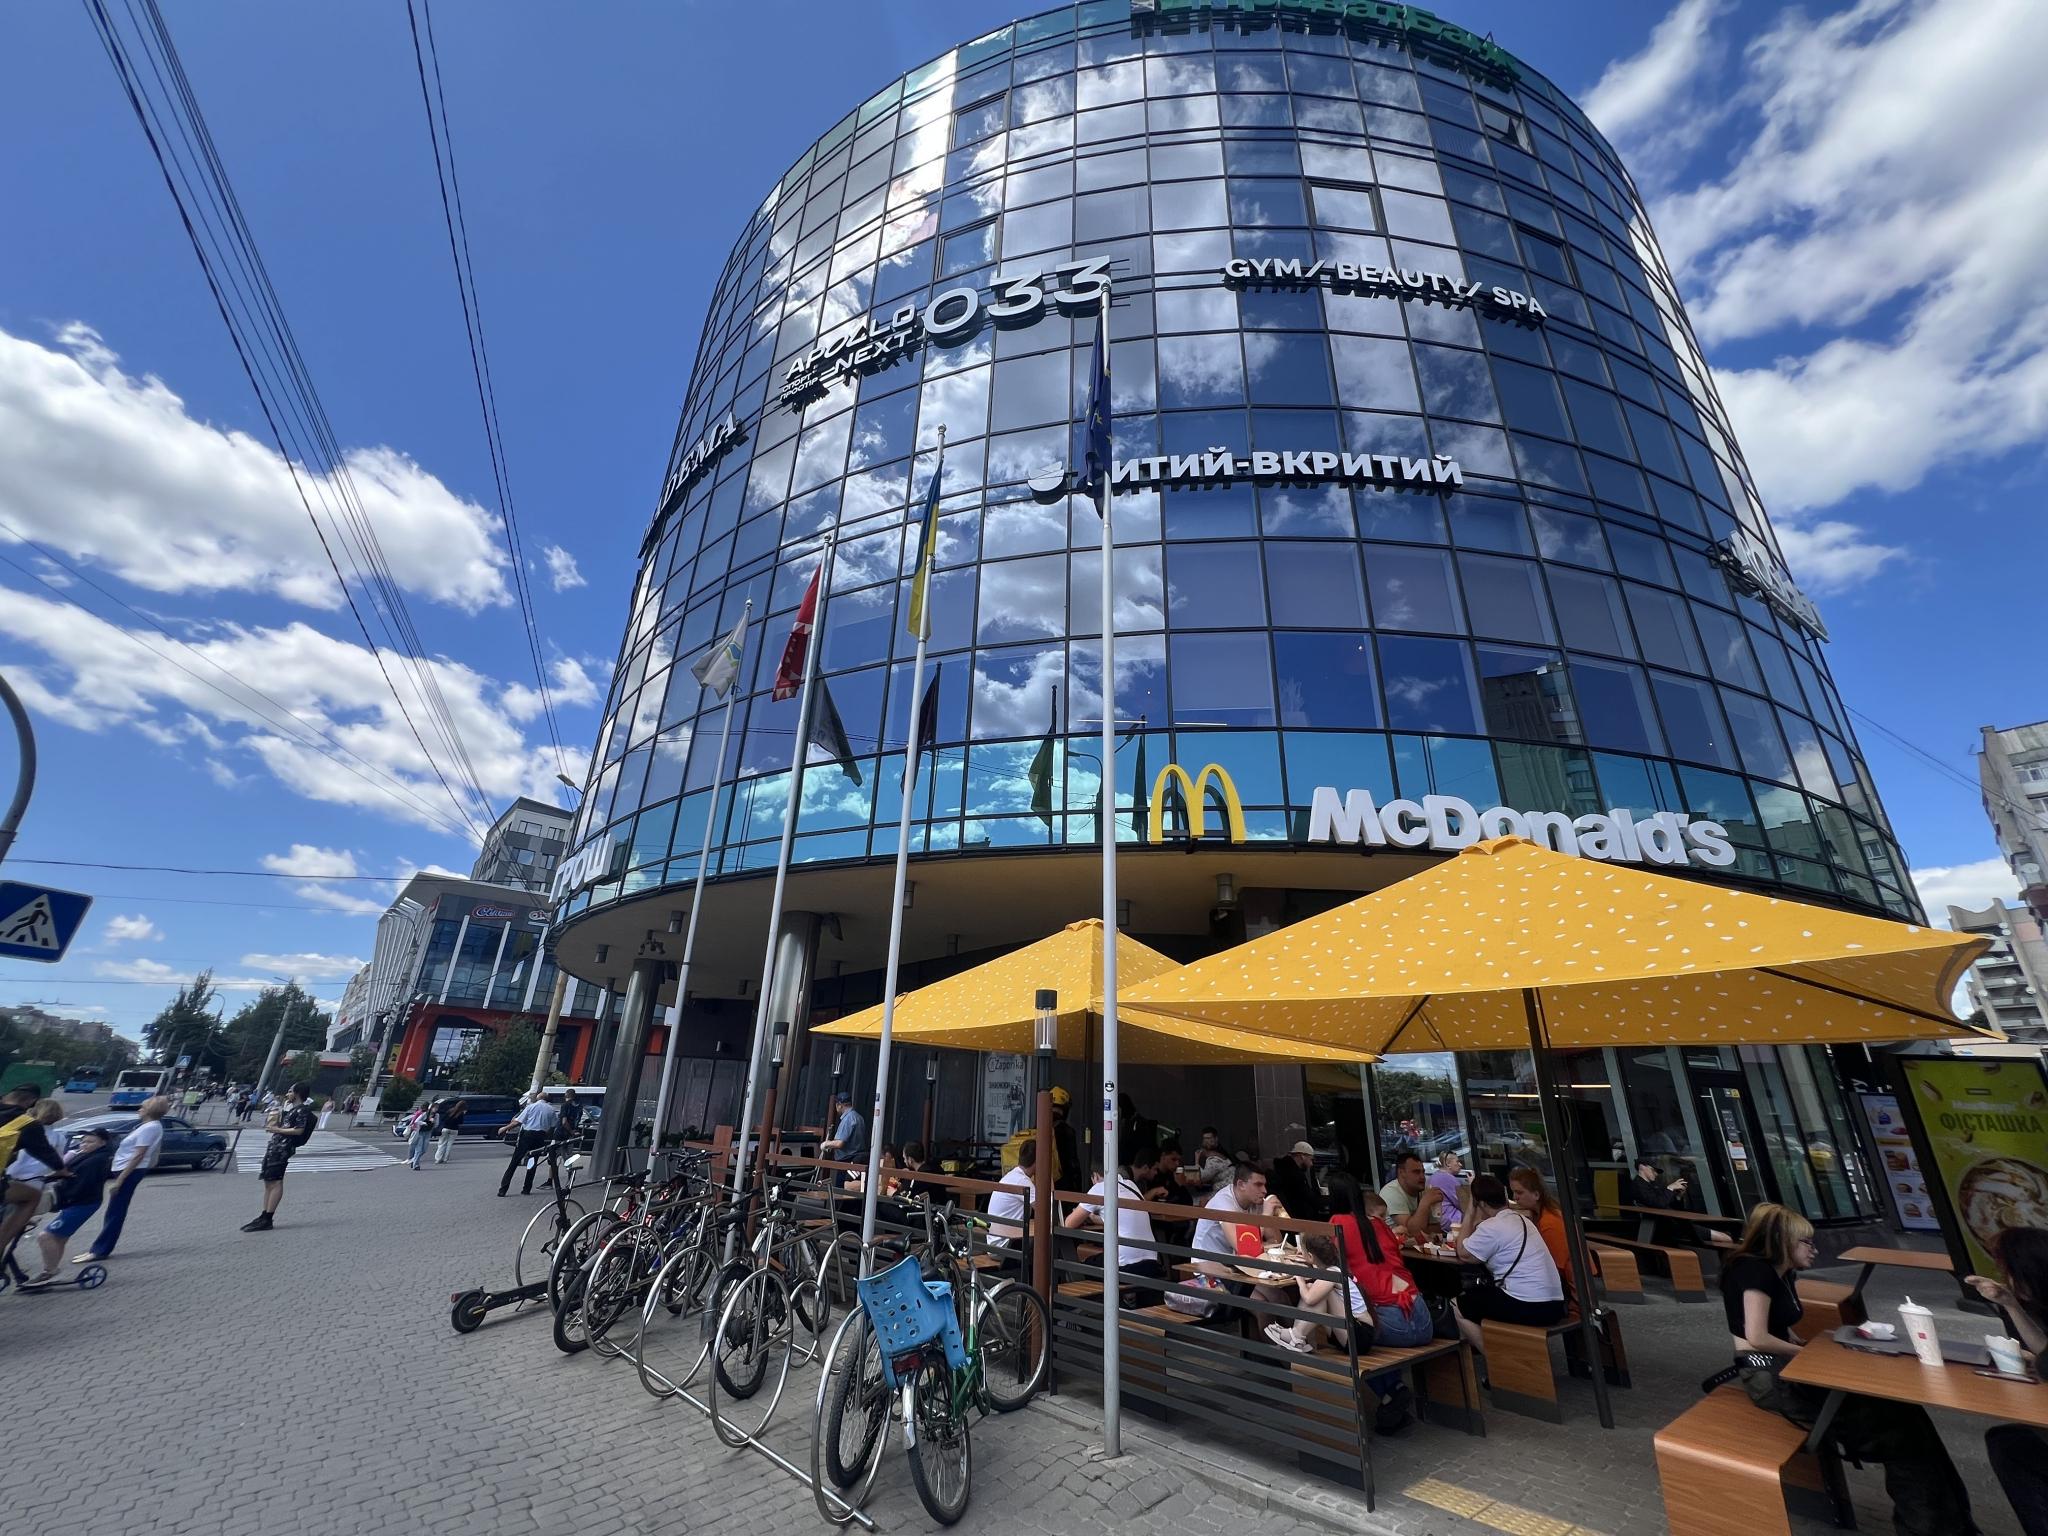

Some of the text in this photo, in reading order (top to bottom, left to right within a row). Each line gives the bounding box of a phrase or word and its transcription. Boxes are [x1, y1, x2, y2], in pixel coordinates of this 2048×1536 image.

[924, 254, 1111, 333] 033
[1492, 285, 1547, 317] SPA
[786, 304, 916, 380] APOLLO
[824, 328, 912, 379] NEXT
[1110, 446, 1464, 485] ИТИЙ-ВКРИТИЙ
[1308, 787, 1737, 866] McDonald's
[1941, 1112, 2045, 1133] ФІСТАШКА
